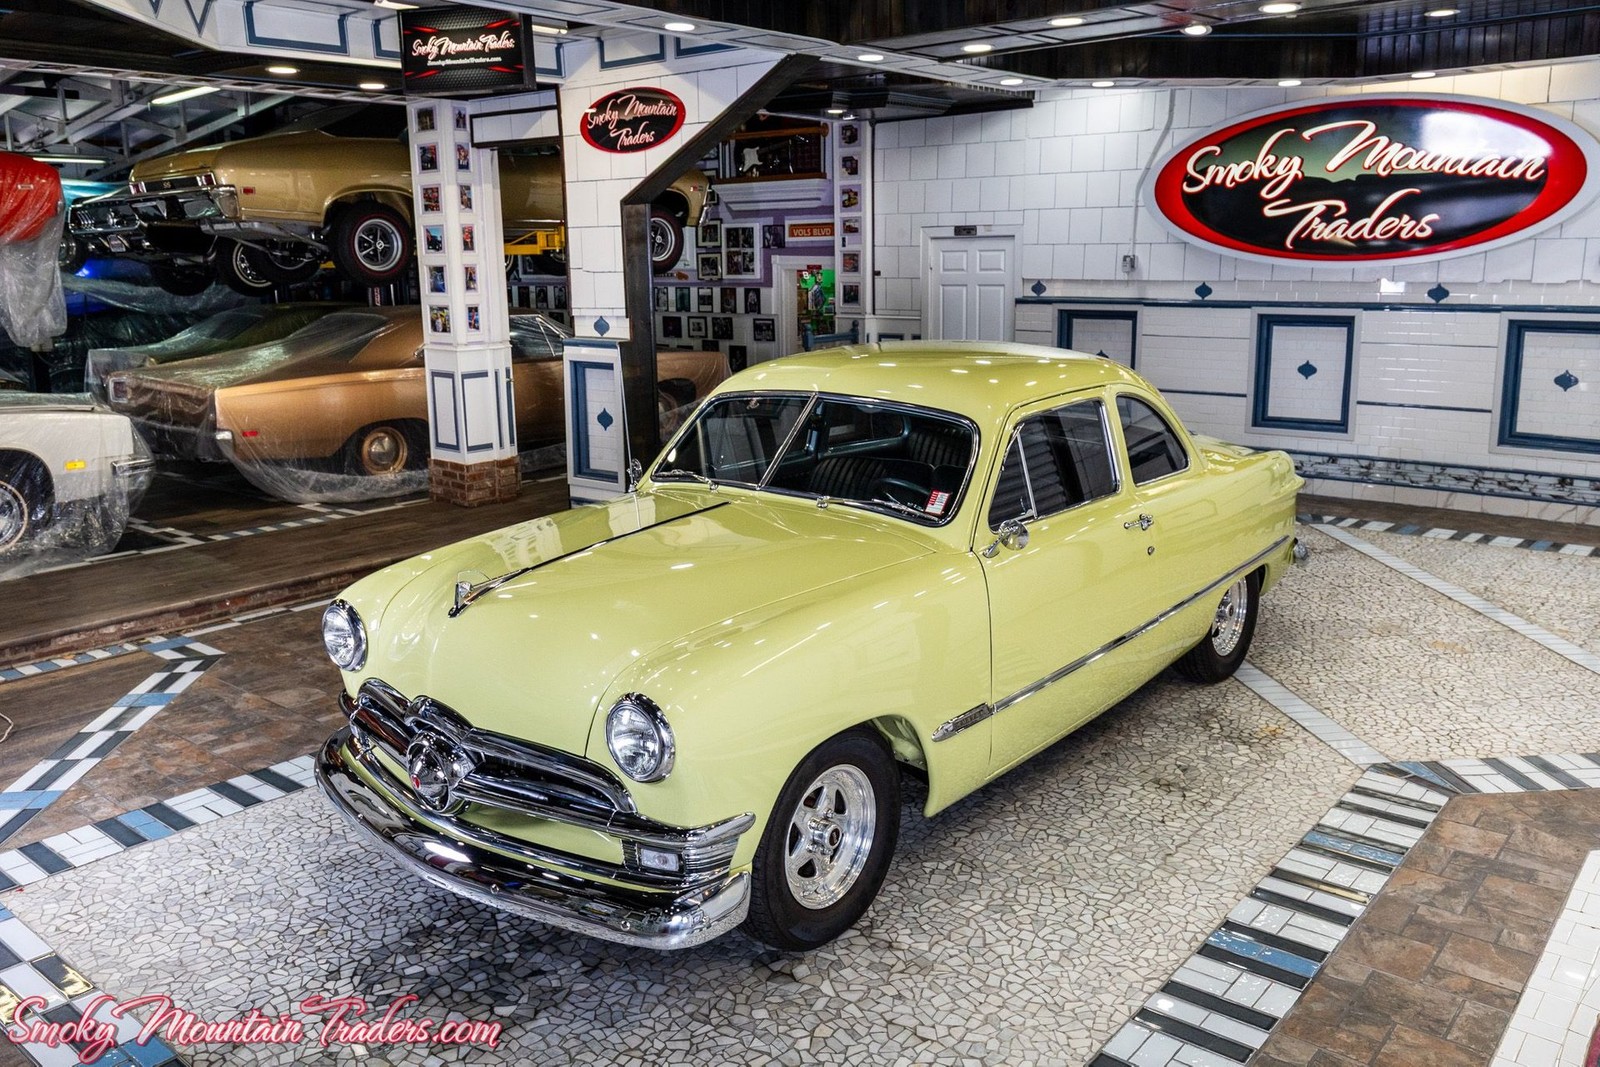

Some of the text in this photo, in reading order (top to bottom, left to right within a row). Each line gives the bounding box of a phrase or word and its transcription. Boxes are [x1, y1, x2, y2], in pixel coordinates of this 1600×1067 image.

[412, 36, 439, 60] Smoky
[434, 36, 484, 55] Mountain
[587, 94, 677, 129] Smoky Mountain
[610, 121, 655, 150] Traders
[1183, 120, 1546, 199] Smoky Mountain
[793, 228, 831, 236] VOLS BLVD
[1263, 188, 1440, 249] Traders
